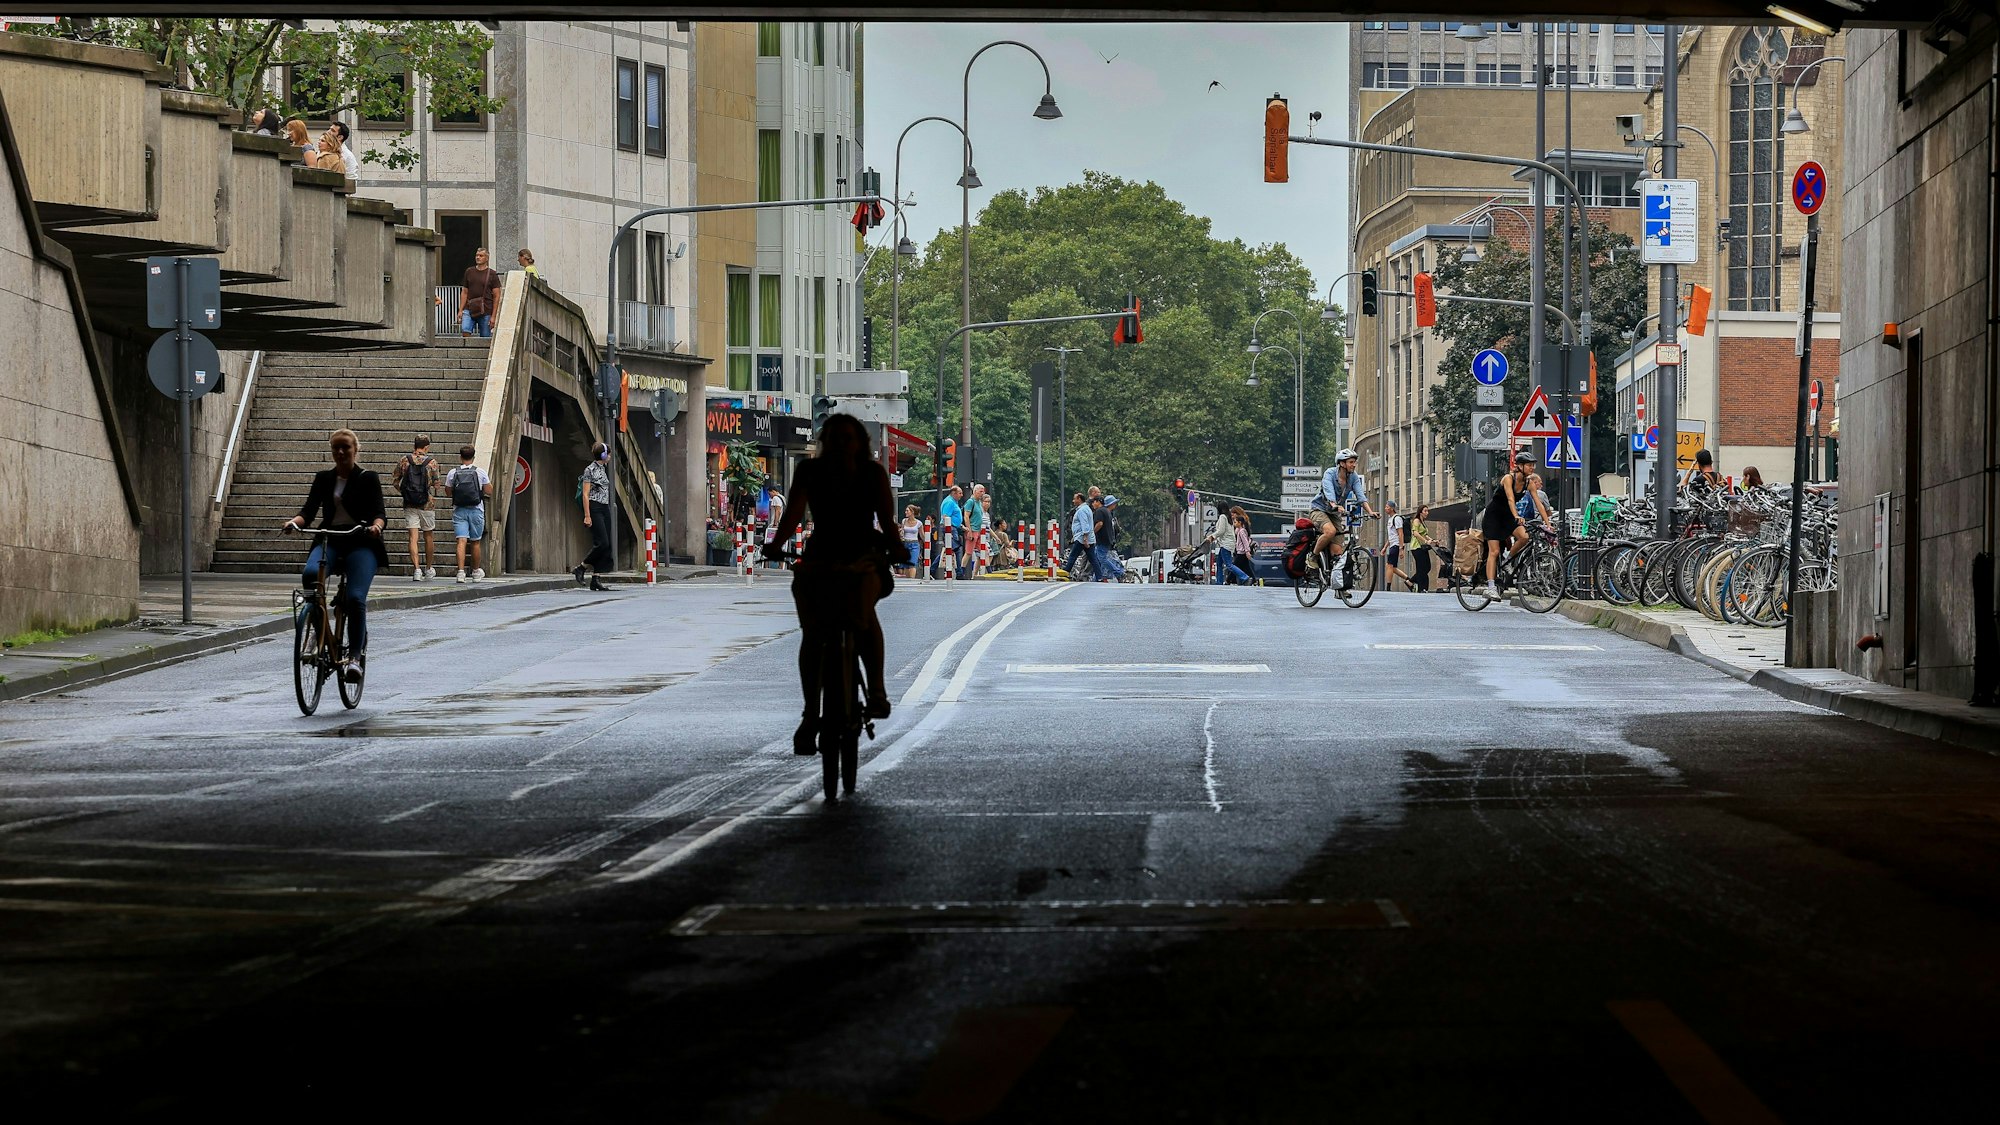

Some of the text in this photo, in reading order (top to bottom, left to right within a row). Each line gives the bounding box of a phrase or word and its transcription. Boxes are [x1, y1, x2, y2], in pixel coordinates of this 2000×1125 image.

[1269, 128, 1279, 173] Signalbau
[628, 373, 688, 394] INFORMATION
[715, 411, 742, 434] VAPE
[1634, 436, 1645, 449] U
